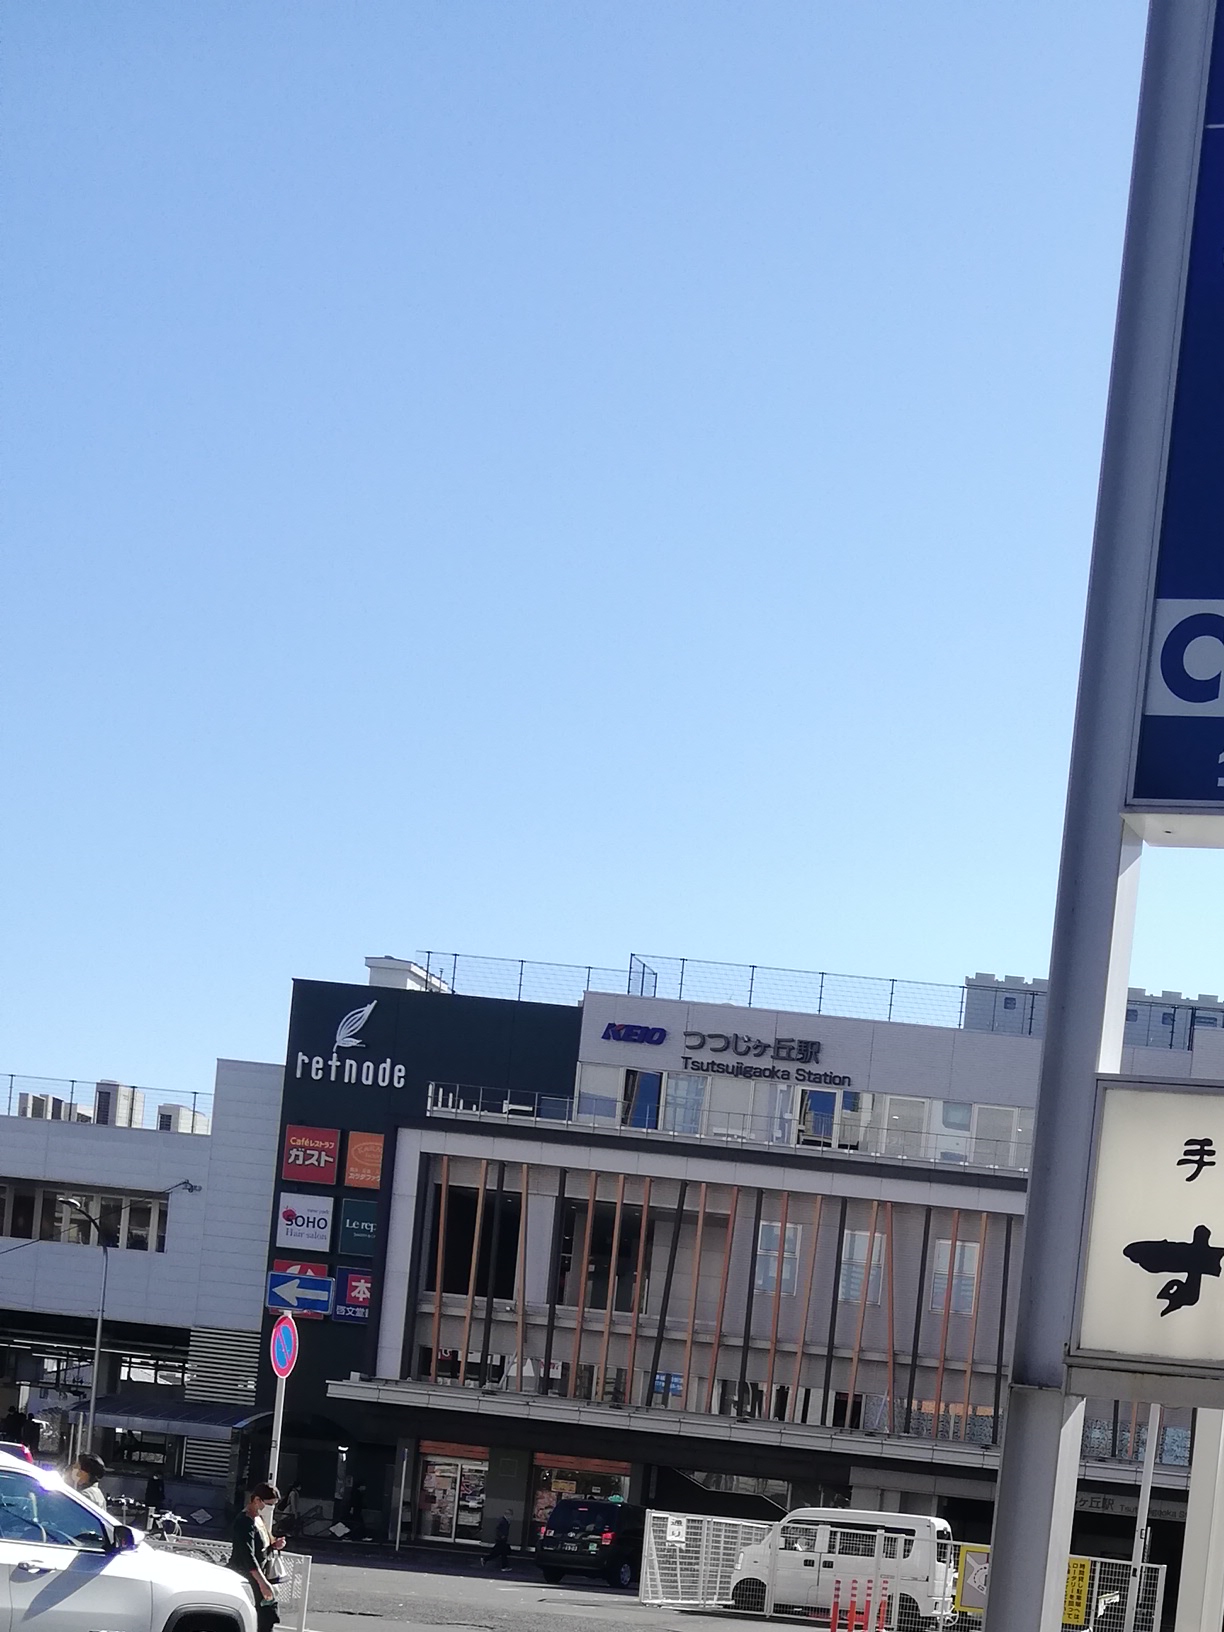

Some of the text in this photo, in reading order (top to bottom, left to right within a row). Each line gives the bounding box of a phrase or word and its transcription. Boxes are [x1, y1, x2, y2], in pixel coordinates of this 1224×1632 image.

[601, 1022, 667, 1046] KEIO
[681, 1056, 852, 1087] Tsutsujigaoka Station
[288, 1147, 334, 1168] ガスト
[285, 1227, 327, 1241] Hair salon
[350, 1279, 371, 1302] 本
[336, 1304, 369, 1318] 啓文堂
